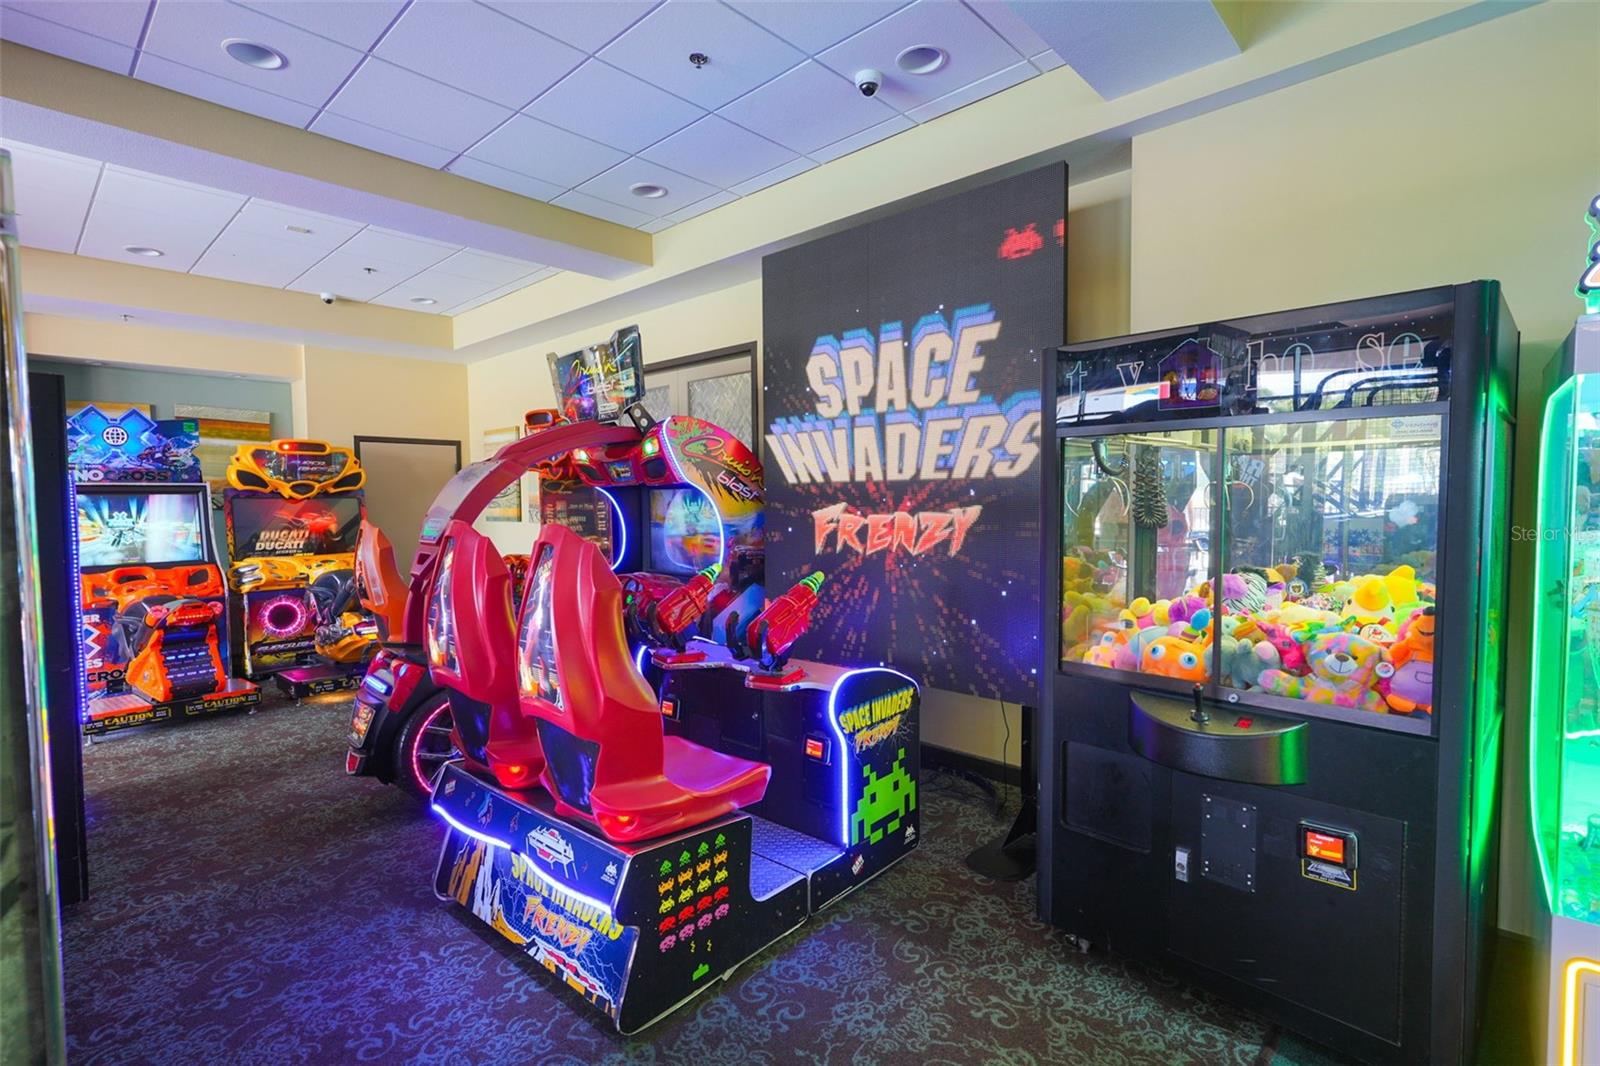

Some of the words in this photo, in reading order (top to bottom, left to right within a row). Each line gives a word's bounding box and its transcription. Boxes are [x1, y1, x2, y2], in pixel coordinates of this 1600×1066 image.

[806, 304, 1001, 418] SPACE
[765, 392, 1041, 484] INVADERS
[72, 469, 171, 481] NOCROSS
[717, 470, 760, 500] blast
[255, 540, 305, 551] DUCATI
[812, 502, 983, 557] FRENZY
[104, 711, 154, 725] CAUTION
[204, 695, 247, 709] CAUTION
[839, 703, 872, 734] SPACE
[871, 686, 915, 724] INVADERS
[522, 895, 593, 956] FRENZY
